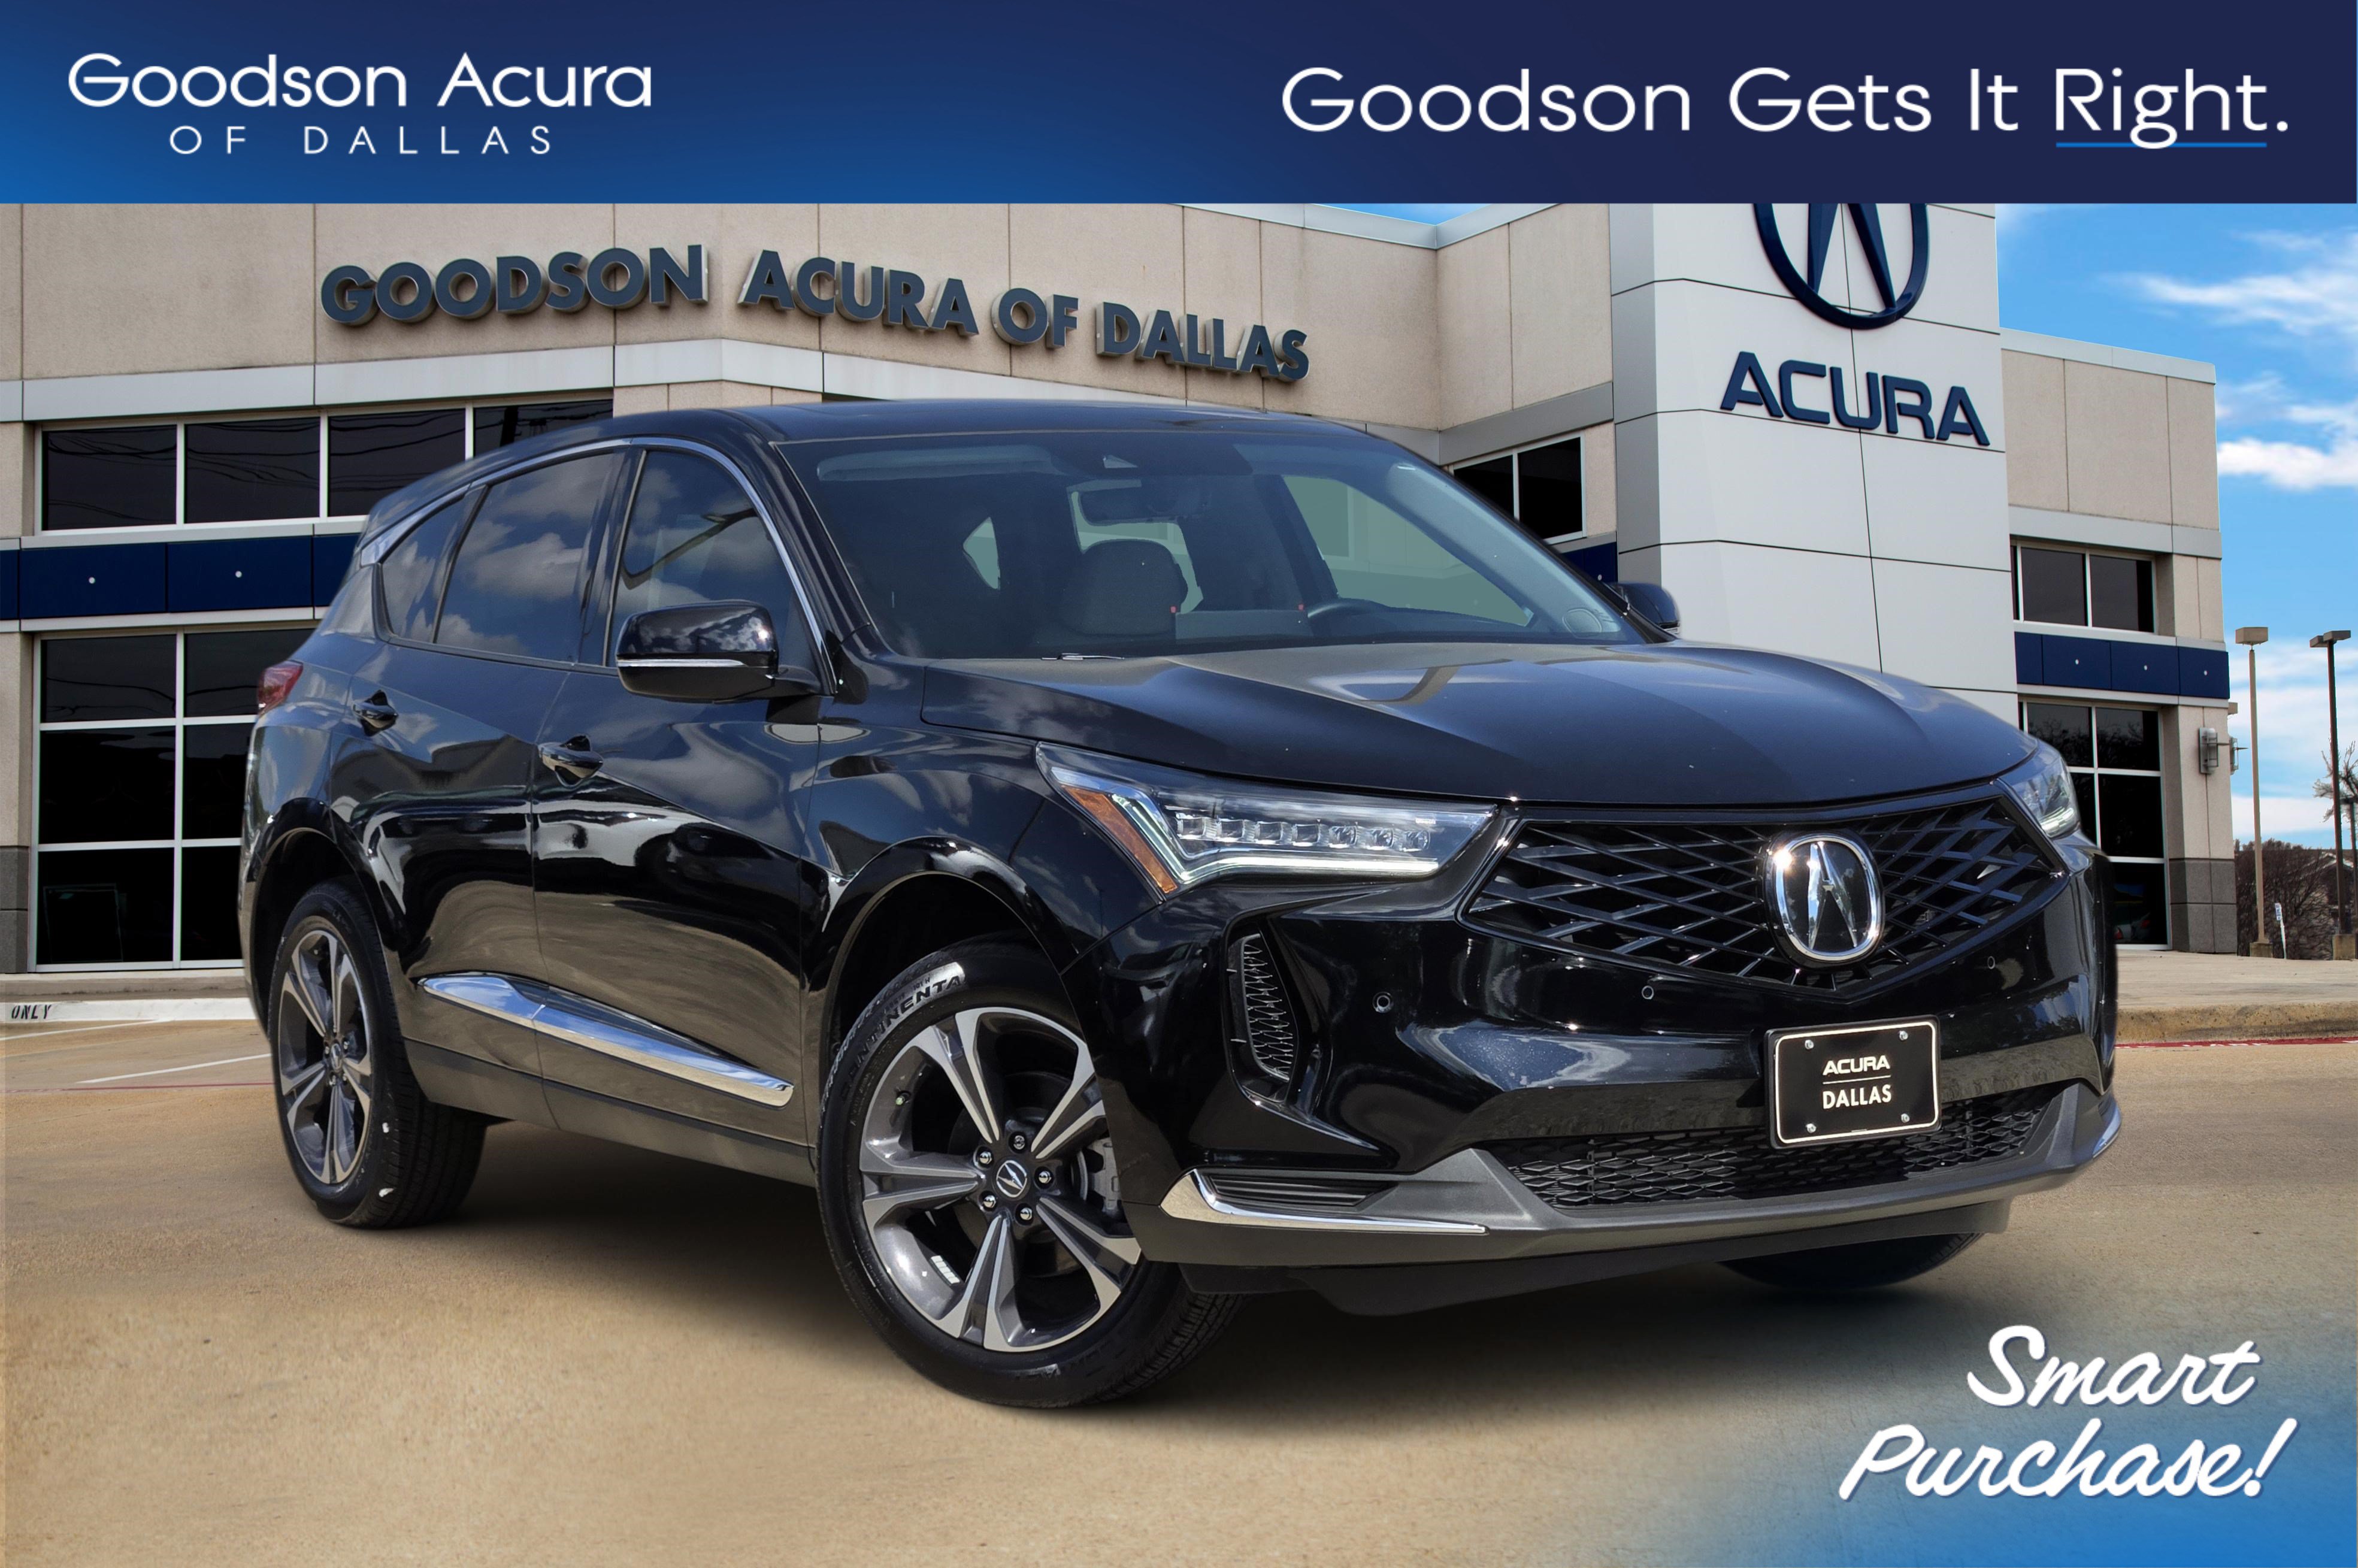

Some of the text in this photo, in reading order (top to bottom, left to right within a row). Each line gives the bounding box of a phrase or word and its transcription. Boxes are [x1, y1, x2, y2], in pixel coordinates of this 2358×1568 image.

[320, 244, 1310, 383] GOODSON ACURA OF DALLAS
[1720, 351, 1990, 446] ACURA
[11, 1004, 52, 1019] ONLY
[1823, 1055, 1890, 1076] ACURA
[1823, 1084, 1891, 1109] DALLAS
